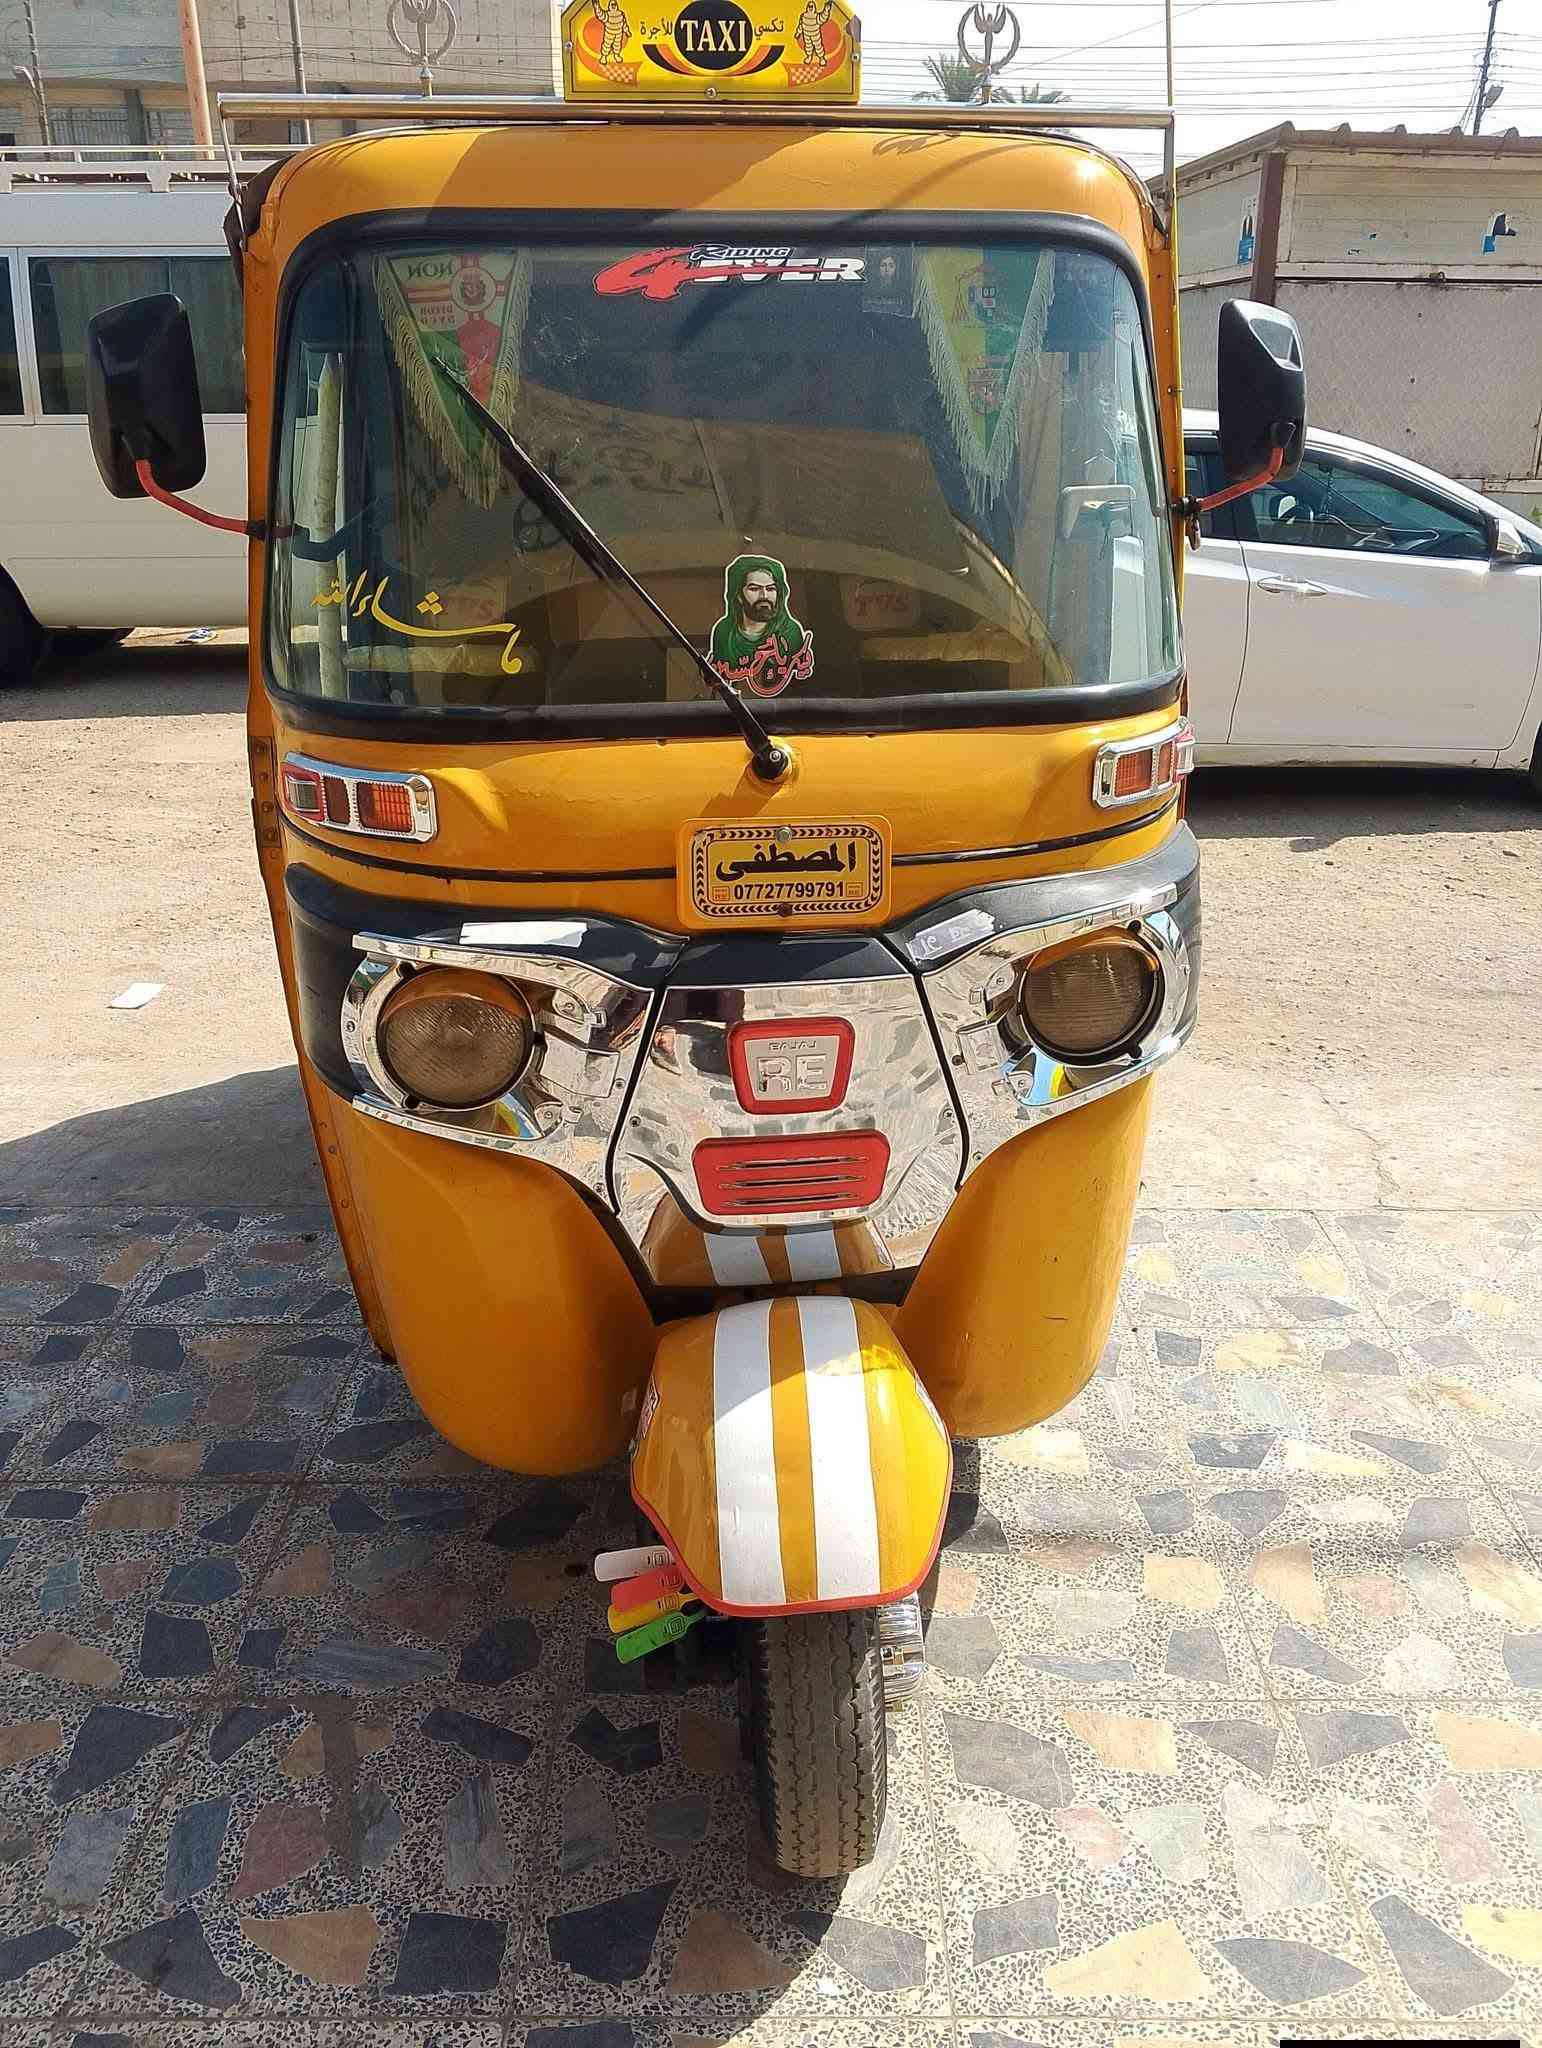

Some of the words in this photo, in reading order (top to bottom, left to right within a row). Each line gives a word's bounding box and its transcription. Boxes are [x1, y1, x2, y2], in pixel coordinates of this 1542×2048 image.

[640, 18, 673, 39] للأجرة
[680, 19, 746, 52] TAXI
[754, 18, 784, 40] تكسي
[689, 243, 790, 260] RIDING
[734, 882, 844, 899] 07727799791
[756, 1053, 828, 1092] RE
